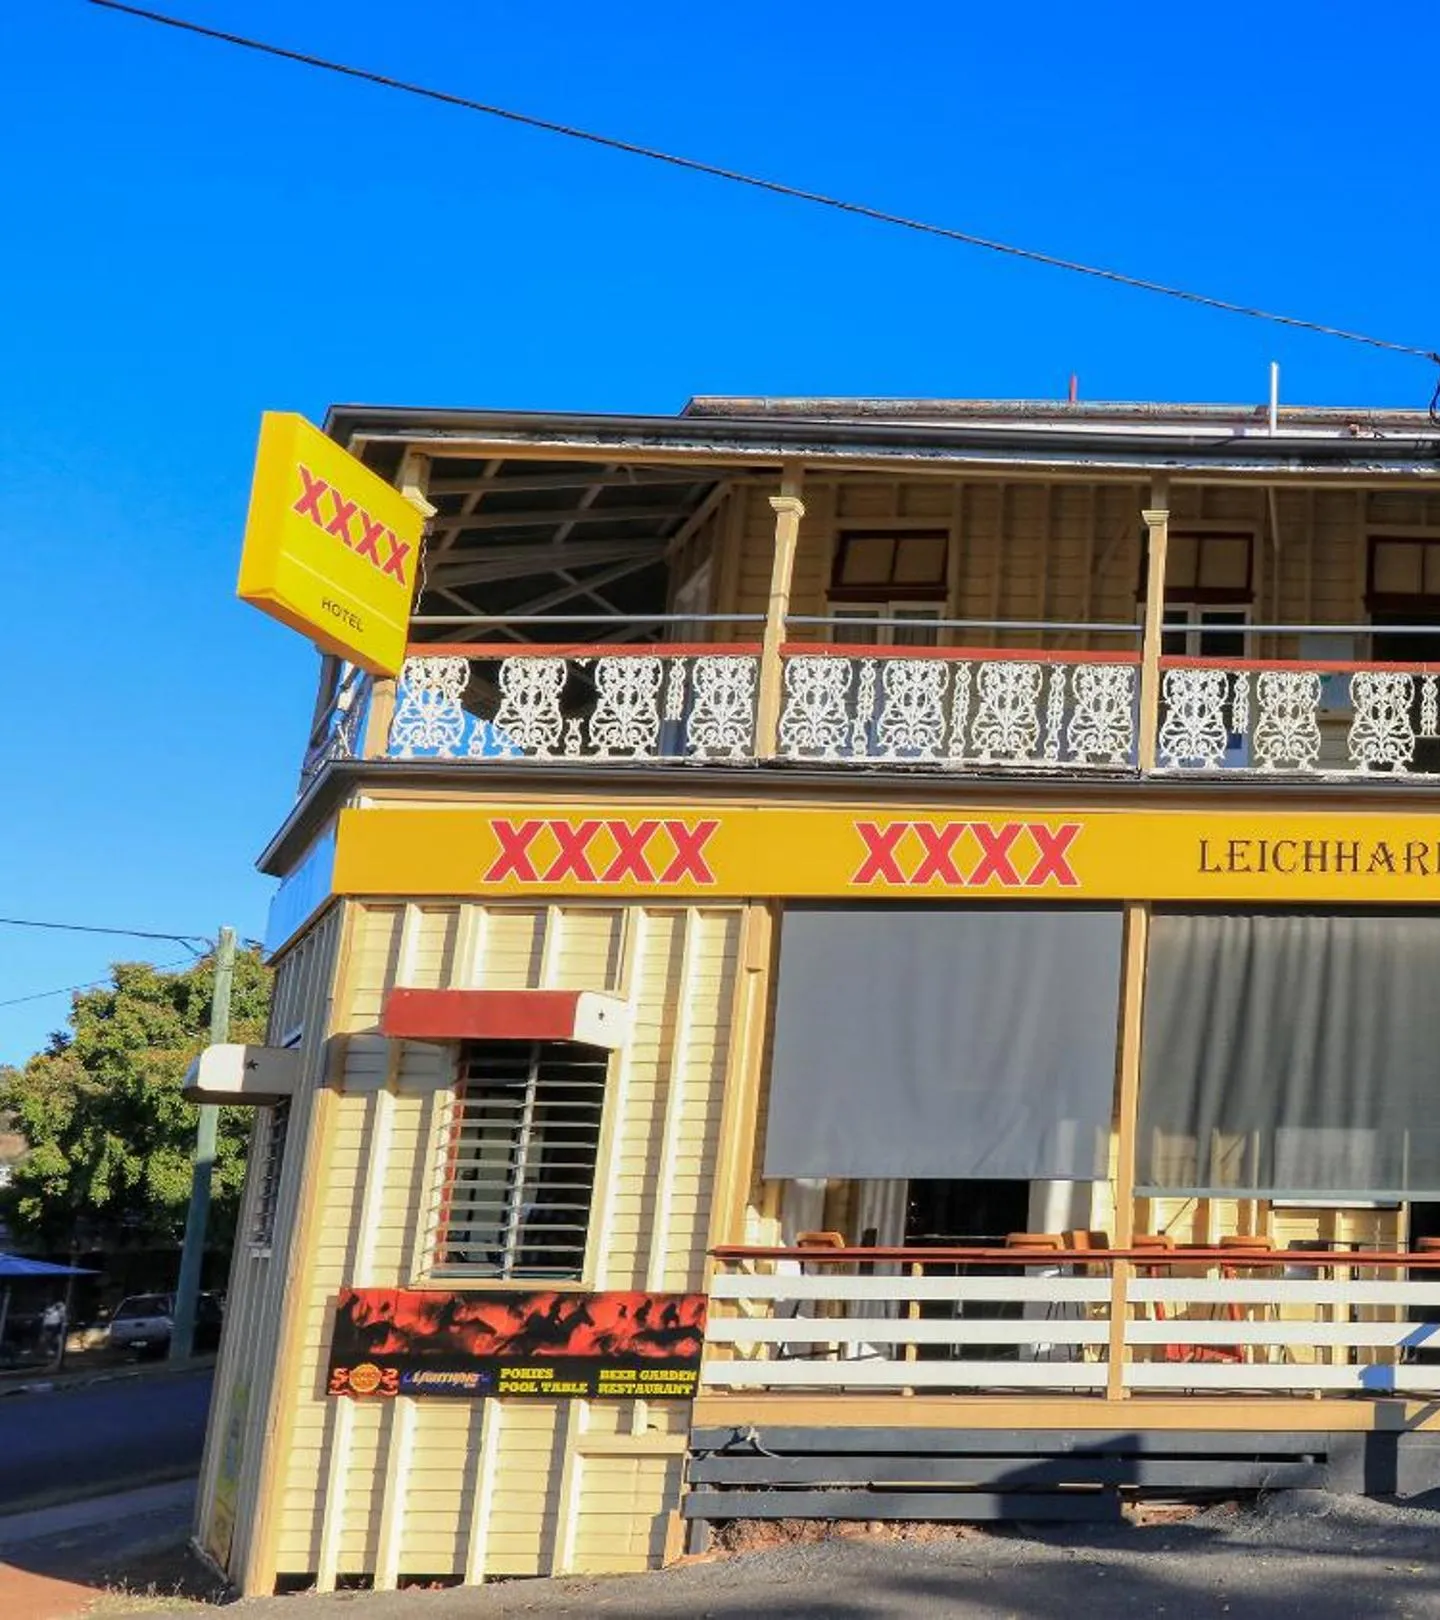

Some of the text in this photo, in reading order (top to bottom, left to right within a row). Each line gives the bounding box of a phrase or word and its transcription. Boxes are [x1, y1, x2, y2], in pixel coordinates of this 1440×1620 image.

[291, 461, 411, 589] XXXX
[321, 597, 363, 632] HOTEL
[481, 819, 721, 885] XXXX
[848, 819, 1084, 888] XXXX
[500, 1368, 554, 1379] POKIES
[600, 1370, 697, 1381] BEER GARDEN
[499, 1382, 588, 1393] POOL TABLE
[598, 1383, 693, 1394] RESTAURANT
